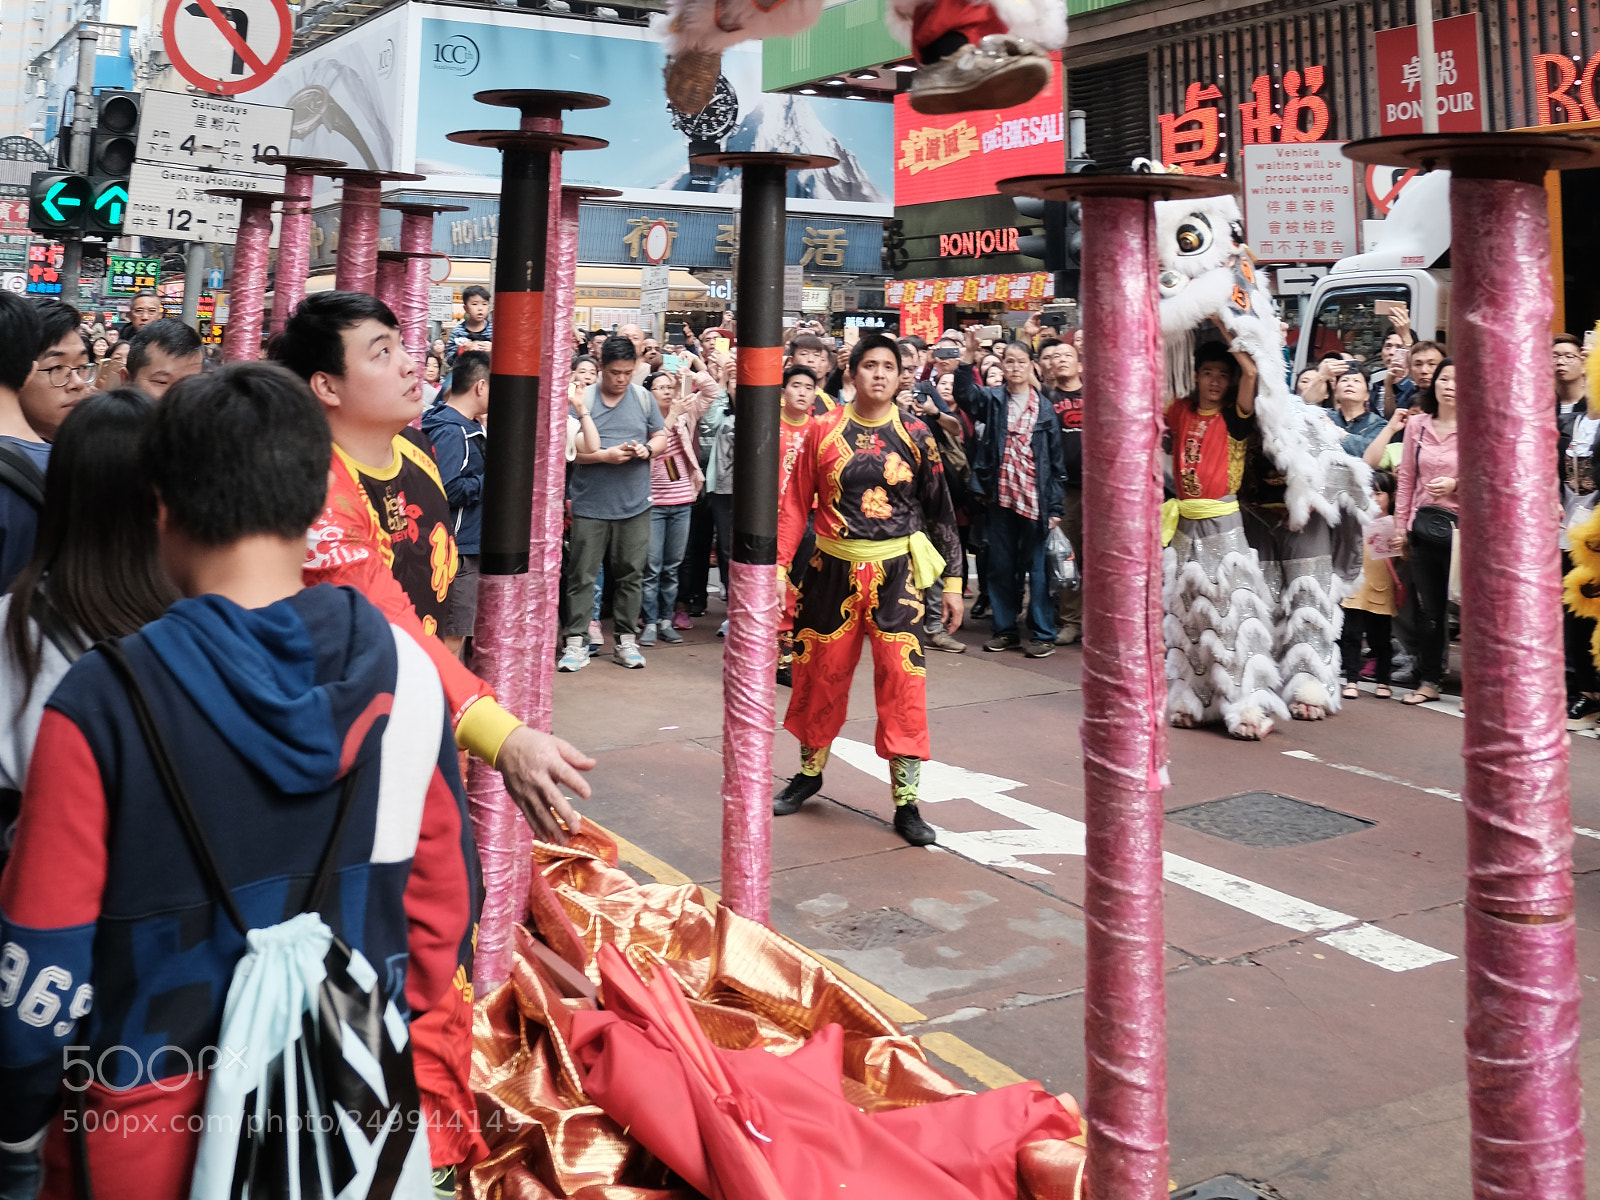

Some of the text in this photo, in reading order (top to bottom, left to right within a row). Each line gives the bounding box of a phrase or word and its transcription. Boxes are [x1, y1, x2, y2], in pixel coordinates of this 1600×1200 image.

[190, 99, 248, 115] Saturdays
[1386, 92, 1475, 122] BONOUR
[194, 114, 240, 133] 星期六
[152, 129, 241, 148] pm pm
[1002, 117, 1030, 150] BIG
[146, 141, 174, 156] 下午
[180, 134, 197, 156] 4
[217, 150, 245, 166] 下午
[1275, 148, 1320, 158] Vehicle
[1256, 160, 1342, 171] waiting will be
[161, 170, 257, 189] General Holidays
[1265, 173, 1333, 183] prosecuted
[1251, 185, 1349, 195] without warning
[132, 202, 235, 221] noon pm
[1266, 200, 1335, 214] 停車等候
[132, 216, 159, 229] 中午
[167, 208, 193, 231] 12
[1268, 220, 1336, 234] 會被檢控
[940, 227, 1020, 258] BONJOUR
[1259, 240, 1345, 255] 而不予警告
